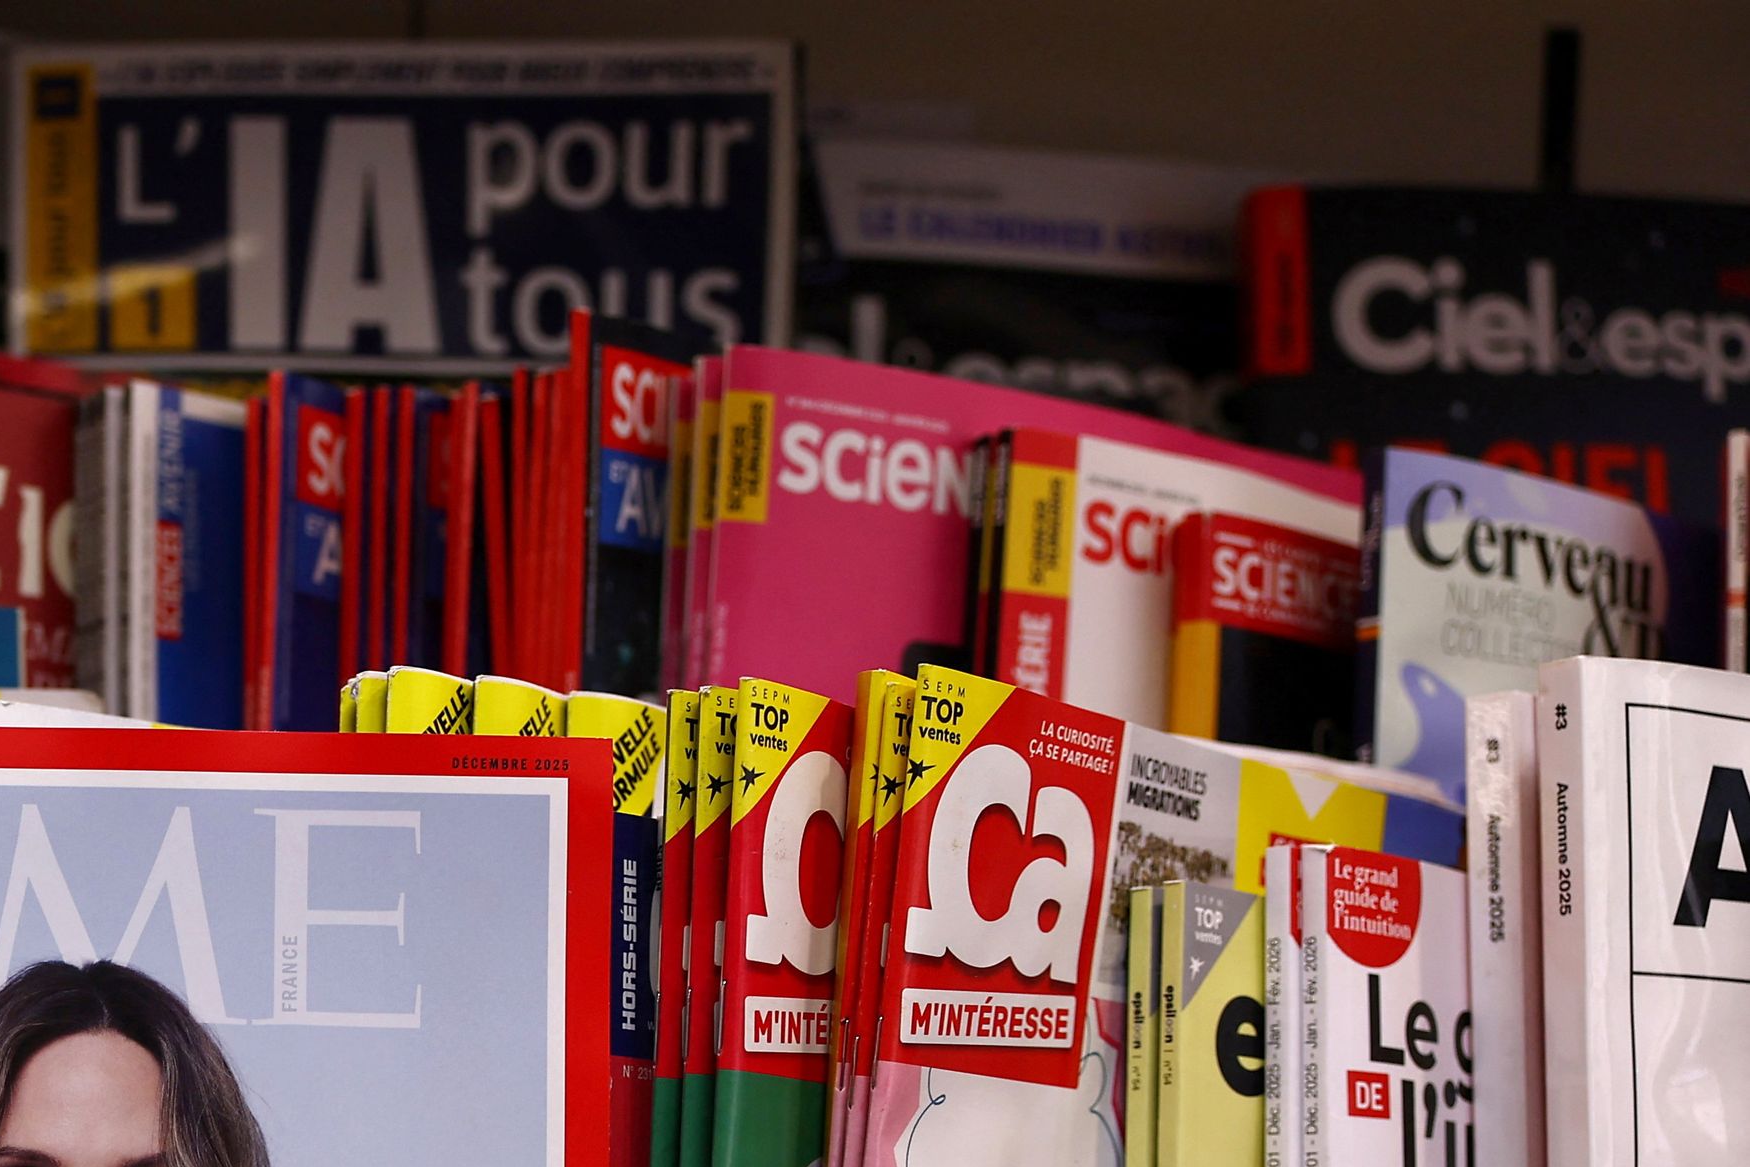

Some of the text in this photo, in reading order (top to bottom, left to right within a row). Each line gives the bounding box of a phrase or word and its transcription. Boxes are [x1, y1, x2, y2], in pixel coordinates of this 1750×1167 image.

[467, 117, 750, 237] pour
[1405, 479, 1650, 612] Cerveau
[751, 685, 791, 706] SEPM
[922, 677, 966, 699] SEPM
[750, 702, 790, 733] TOP
[921, 695, 965, 727] TOP
[1554, 703, 1568, 730] #3
[749, 732, 789, 752] ventes
[918, 725, 962, 746] ventes
[1040, 719, 1117, 757] LA CURIOSITÉ,
[451, 755, 570, 772] DÉCEMBRE 2025
[1061, 747, 1108, 774] PARTAGE
[1556, 782, 1572, 916] Automne 2025
[1354, 862, 1399, 890] grand
[1333, 886, 1399, 911] guide de
[1194, 906, 1224, 930] TOP
[620, 858, 638, 1031] HORS-SÉRIE
[281, 932, 299, 1014] FRANCE
[910, 996, 1070, 1042] M'INTÉRESSE
[1367, 972, 1440, 1072] Le
[1305, 1062, 1319, 1099] 2025
[1353, 1080, 1385, 1111] DE
